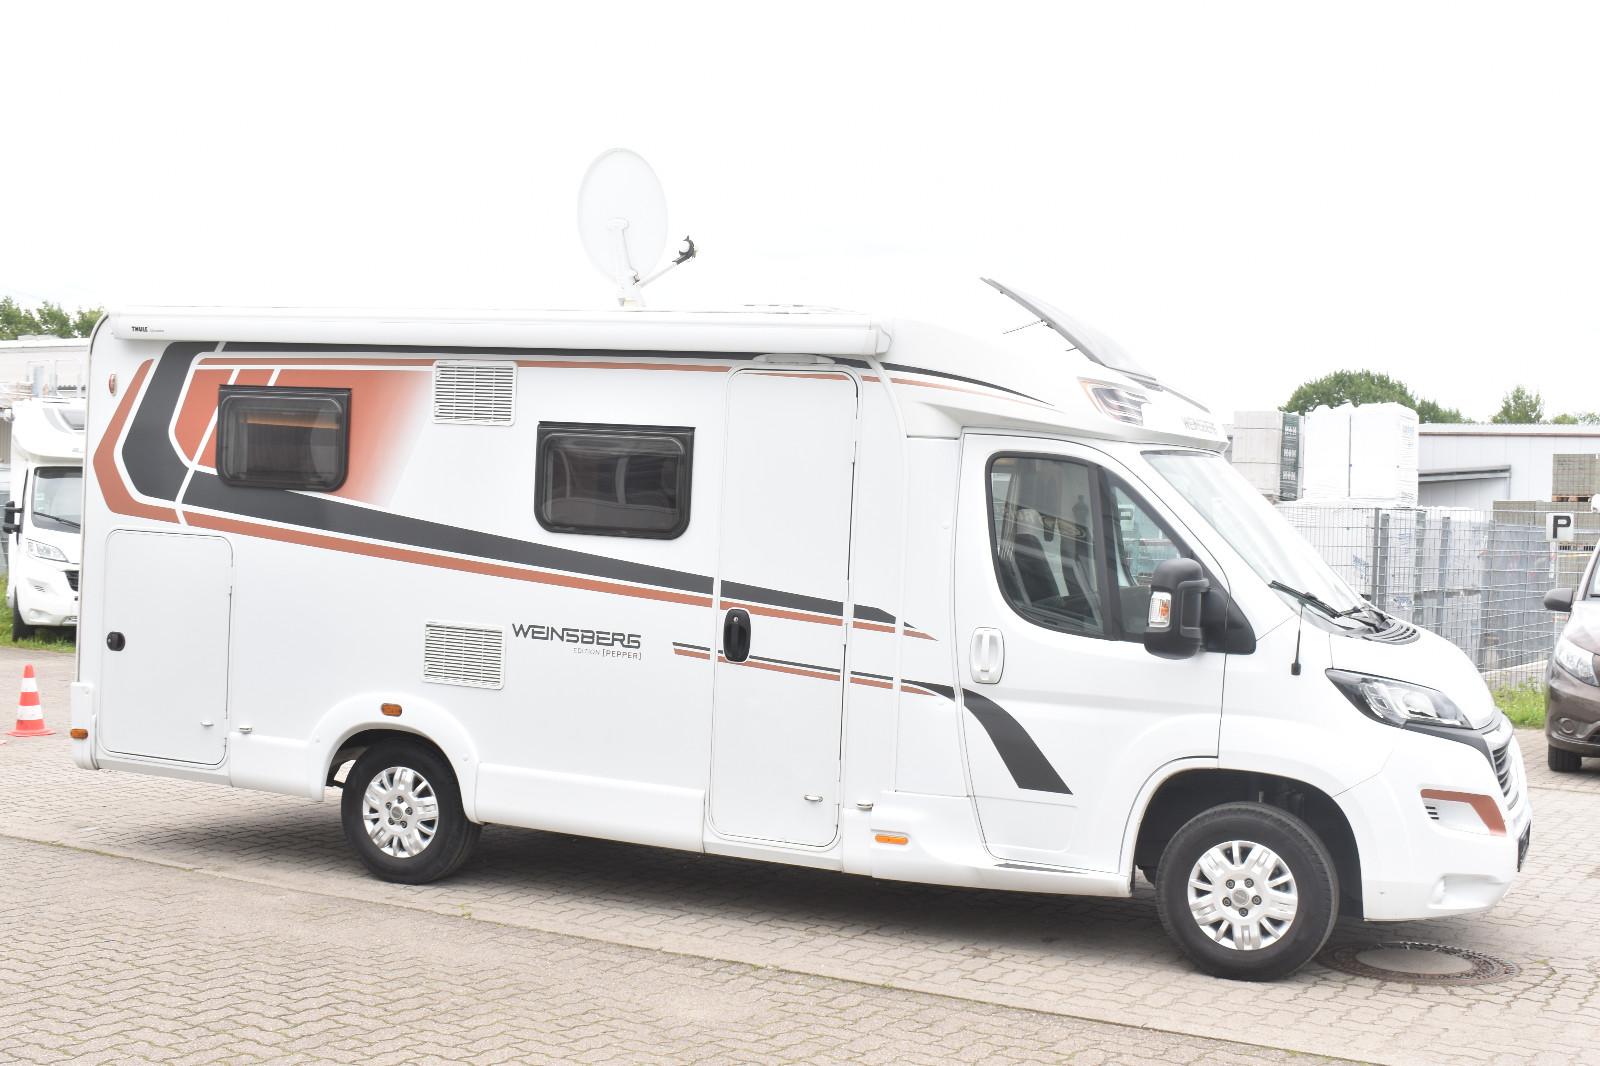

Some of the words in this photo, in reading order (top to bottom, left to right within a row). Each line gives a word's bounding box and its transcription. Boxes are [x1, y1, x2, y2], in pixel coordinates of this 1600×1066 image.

[1552, 515, 1572, 539] P
[511, 622, 642, 649] WEINSBERG
[573, 647, 600, 656] EDITION
